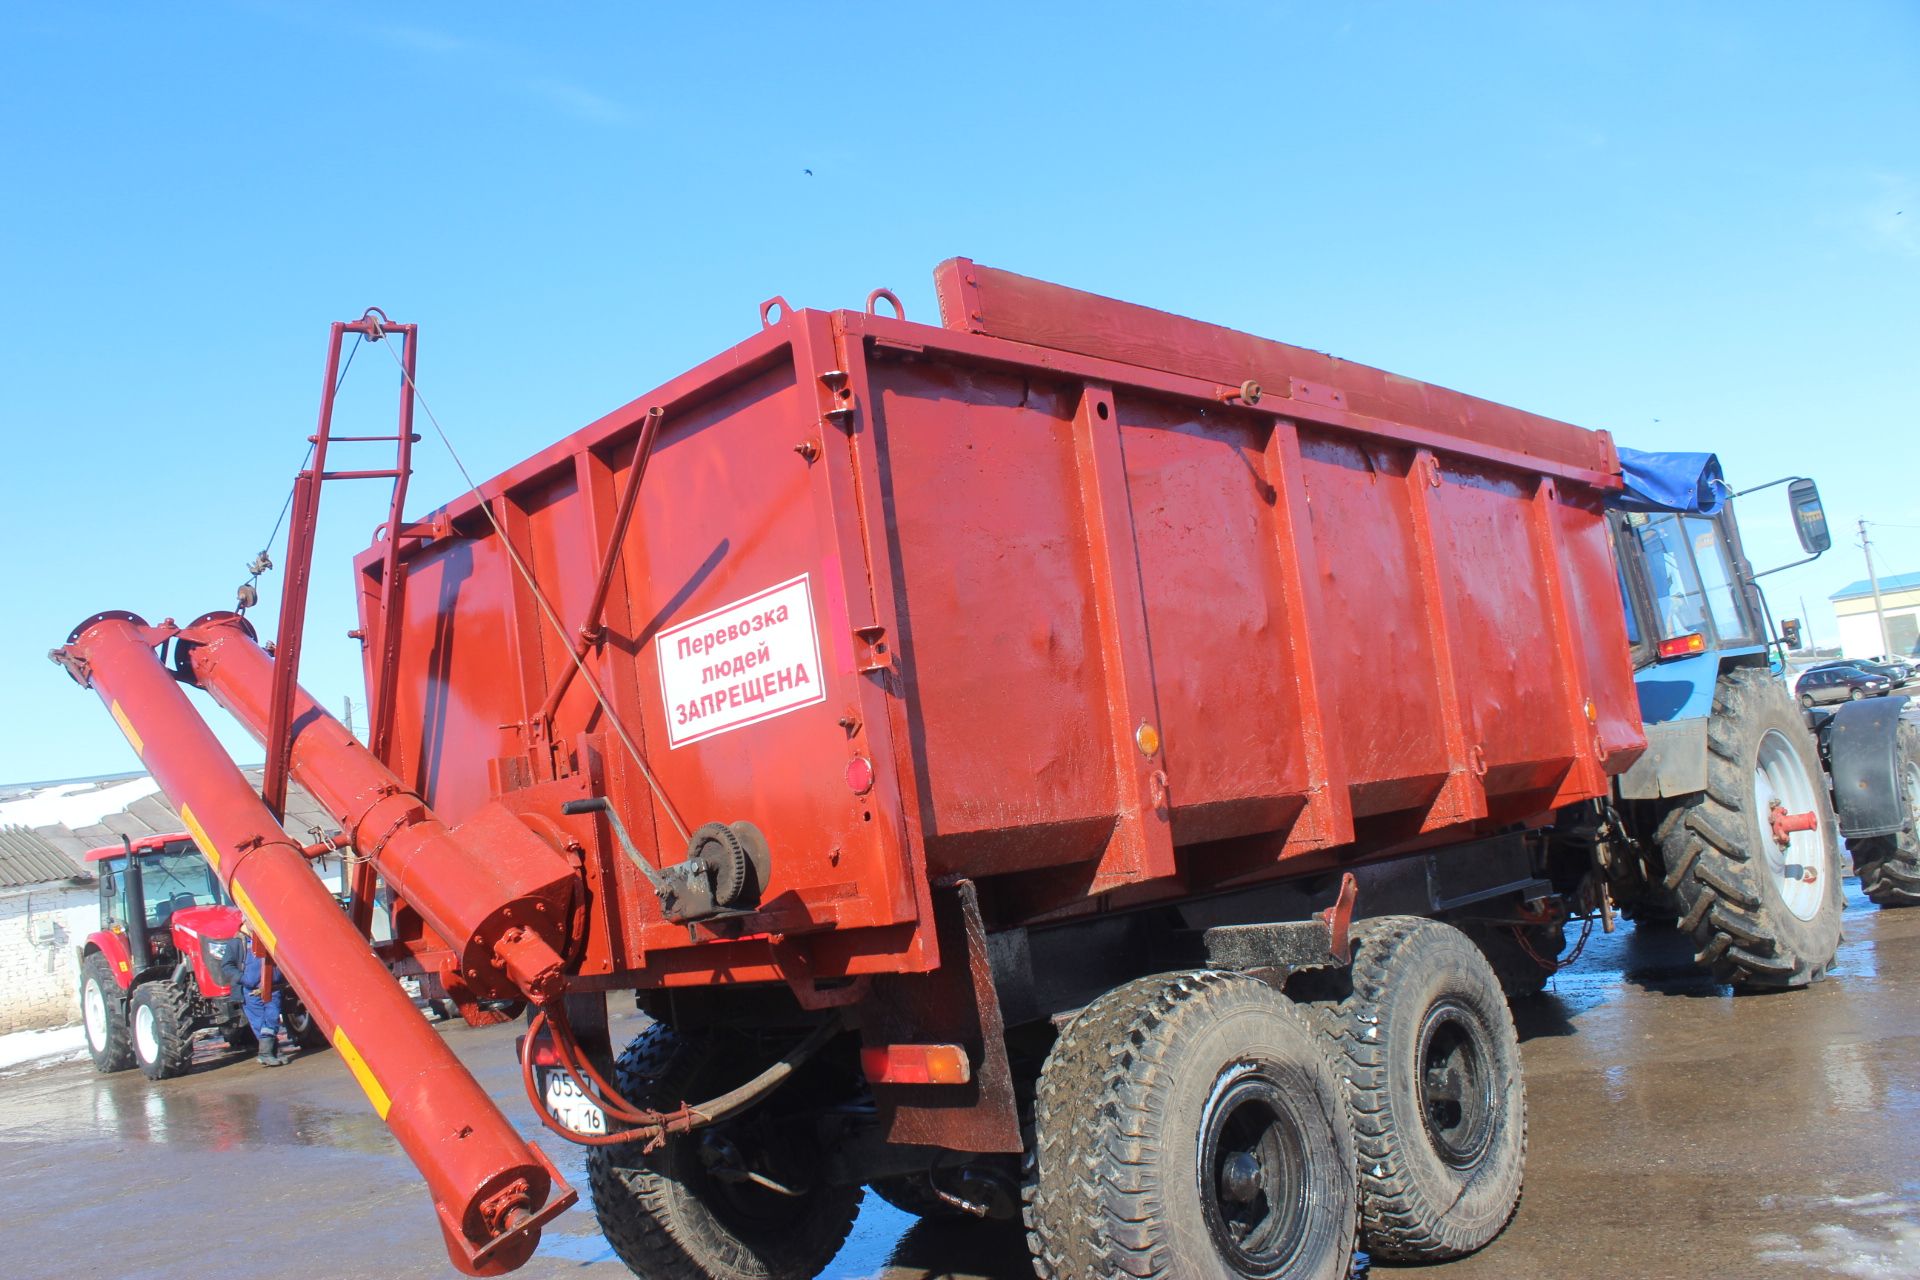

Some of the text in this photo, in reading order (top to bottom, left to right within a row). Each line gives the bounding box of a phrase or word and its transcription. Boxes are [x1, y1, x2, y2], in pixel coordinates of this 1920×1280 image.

[677, 604, 789, 660] Перевозка
[701, 640, 770, 684] людей
[675, 663, 810, 725] ЗАПРЕЩЕНА
[552, 1072, 591, 1097] 057
[584, 1109, 600, 1129] 16
